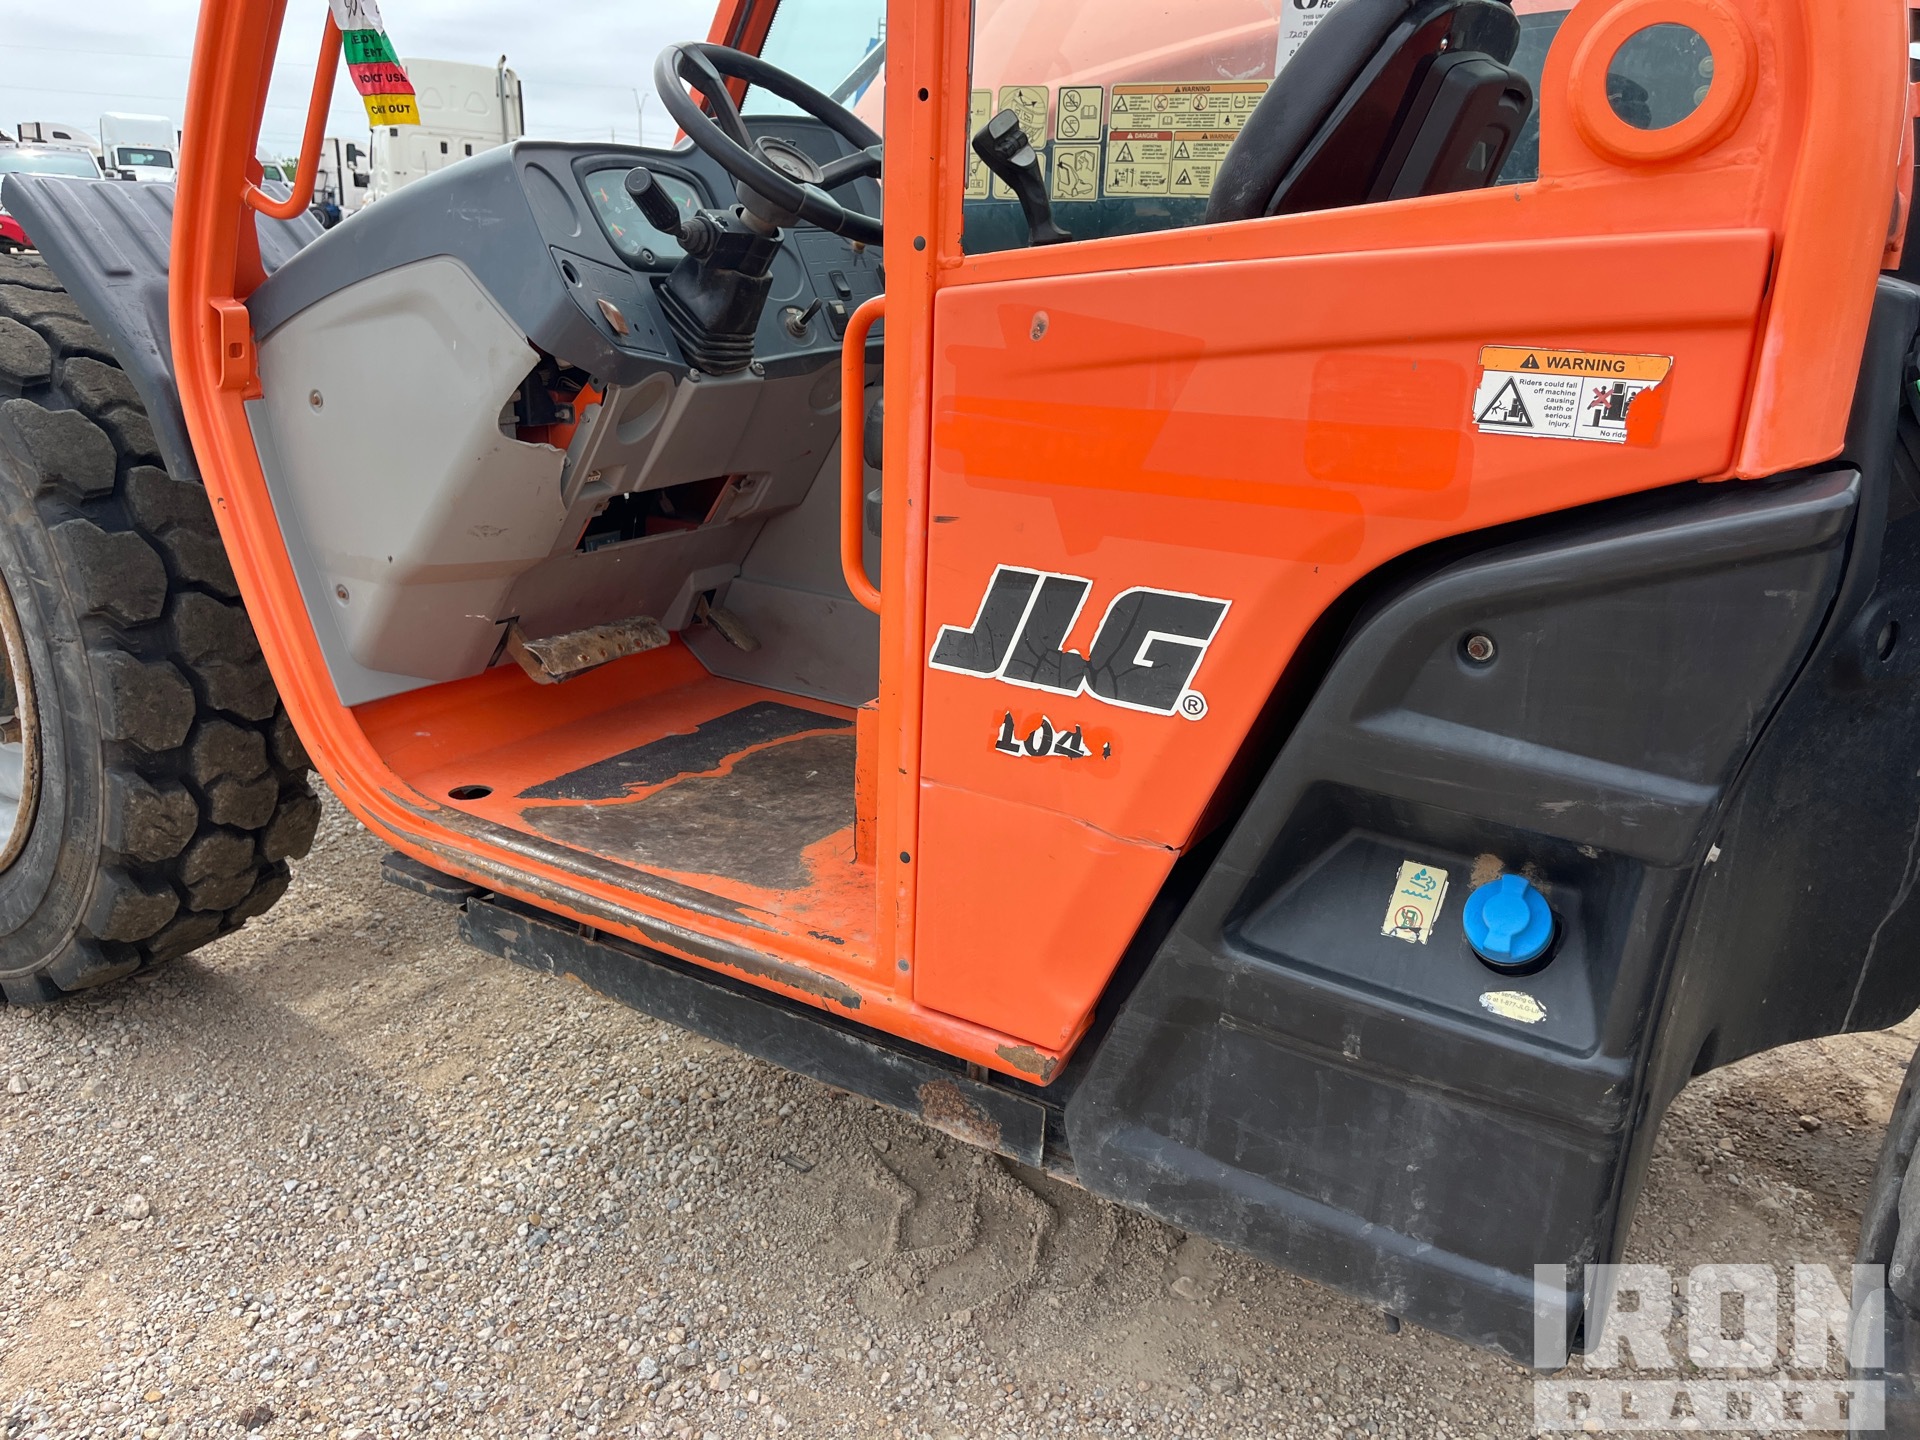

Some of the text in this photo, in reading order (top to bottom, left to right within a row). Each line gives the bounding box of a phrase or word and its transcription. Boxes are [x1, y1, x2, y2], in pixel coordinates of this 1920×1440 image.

[386, 73, 408, 83] USE
[388, 104, 411, 114] OUT
[1546, 356, 1626, 373] WARNING
[1519, 378, 1542, 387] Riders
[1543, 380, 1565, 388] could
[1545, 389, 1576, 397] machine
[1545, 397, 1575, 405] causing
[1543, 404, 1564, 412] death
[1545, 412, 1572, 420] serious
[1548, 420, 1571, 428] injury.
[1612, 430, 1627, 439] ride
[929, 563, 1233, 716] JLG
